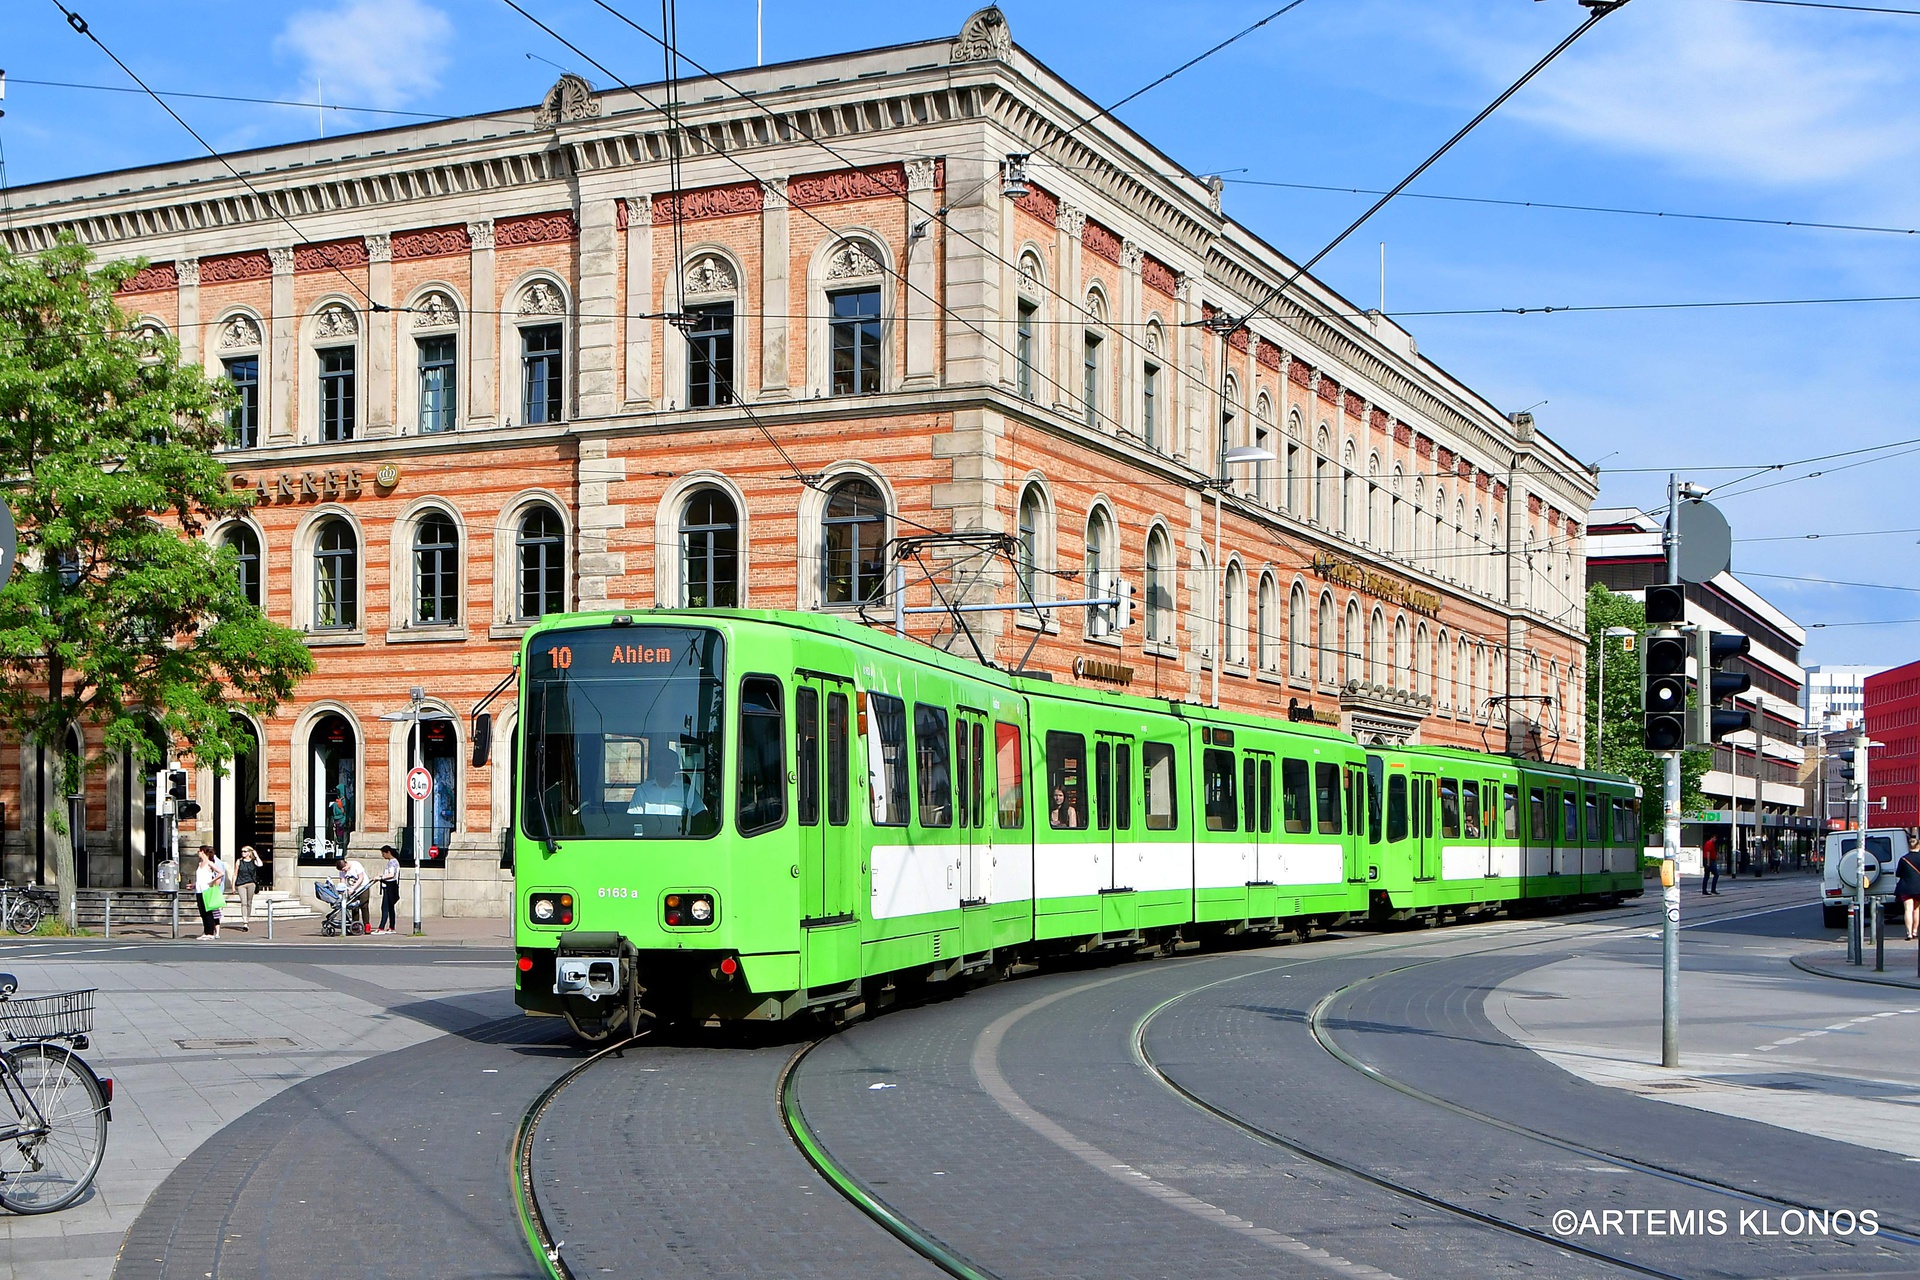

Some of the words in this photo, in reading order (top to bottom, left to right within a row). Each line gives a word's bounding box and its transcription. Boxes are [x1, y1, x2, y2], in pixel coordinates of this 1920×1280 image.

[547, 646, 572, 669] 10
[611, 645, 671, 664] Ahlem
[598, 887, 628, 898] 6163
[631, 889, 638, 899] a
